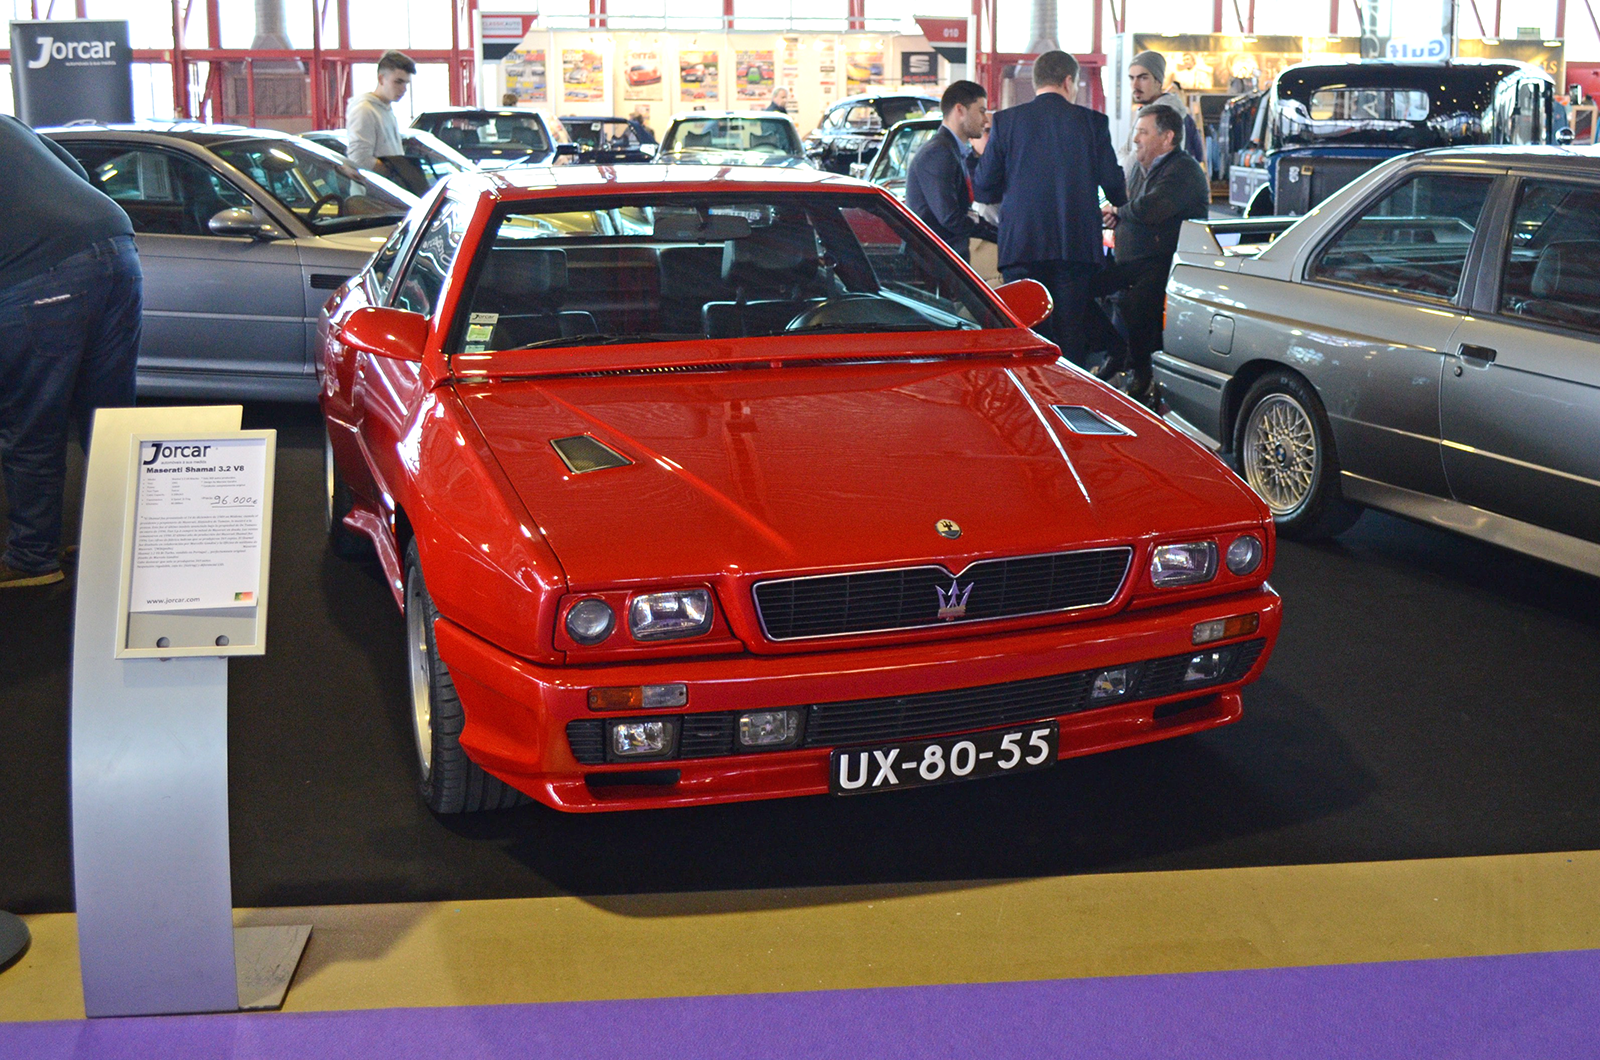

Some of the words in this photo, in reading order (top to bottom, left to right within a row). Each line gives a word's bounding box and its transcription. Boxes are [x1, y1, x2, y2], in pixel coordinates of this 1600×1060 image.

[943, 28, 959, 38] 010
[28, 36, 116, 69] Jorcar
[143, 443, 211, 465] Jorcar
[146, 597, 201, 605] www.jorcar.com
[839, 728, 1050, 790] UX-80-55
